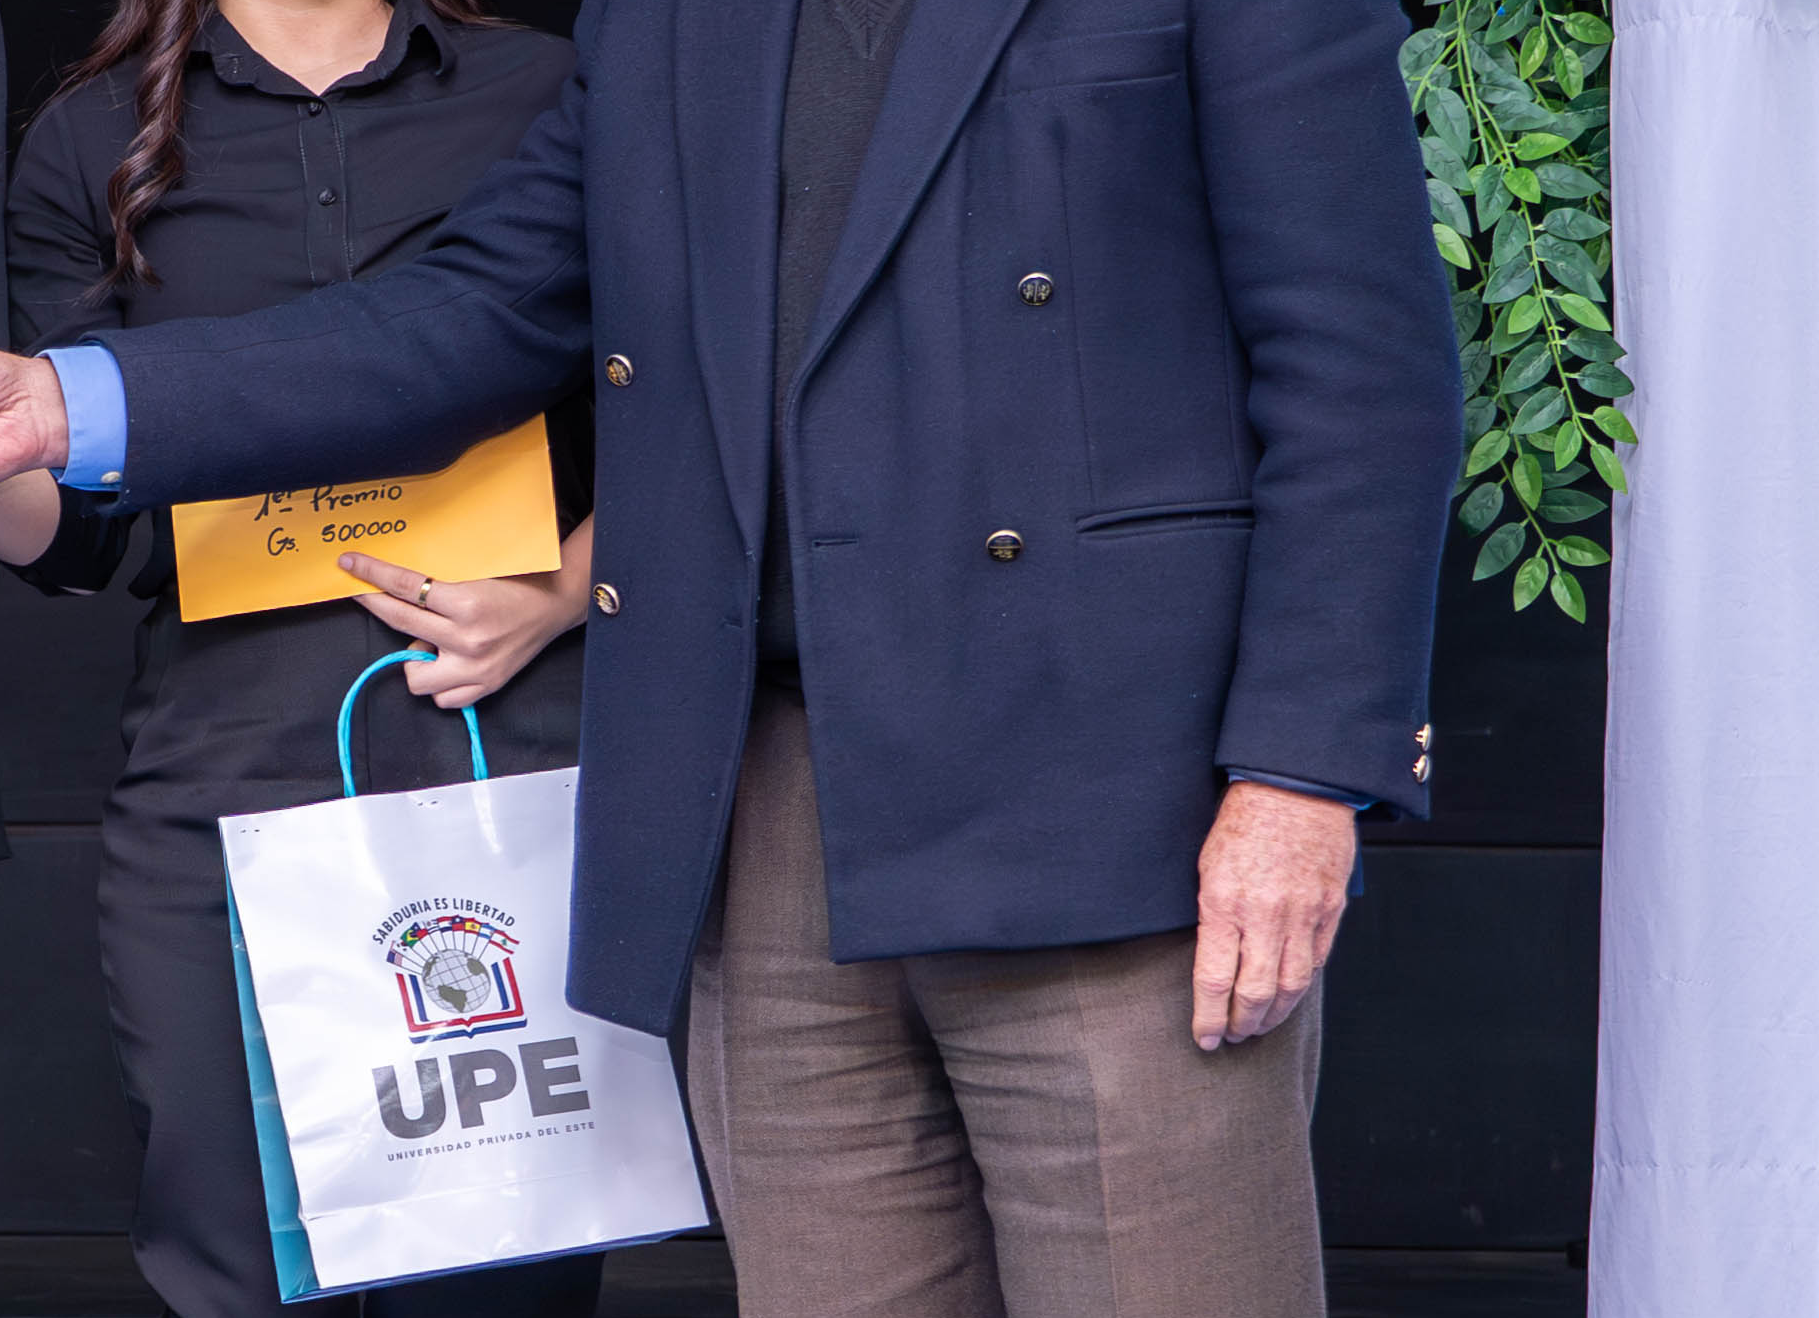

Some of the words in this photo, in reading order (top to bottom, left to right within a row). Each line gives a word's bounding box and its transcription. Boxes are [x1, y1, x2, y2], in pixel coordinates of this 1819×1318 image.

[310, 485, 402, 512] Premio
[321, 519, 406, 542] 500000
[372, 899, 431, 945] SABIDURIA
[434, 897, 449, 911] ES
[453, 898, 515, 927] LIBERTAD
[371, 1036, 591, 1140] UPE
[387, 1140, 472, 1162] UNIVERSIDAD
[478, 1131, 532, 1147] PRIVADA
[538, 1126, 560, 1137] DEL
[565, 1121, 596, 1133] ESTE
